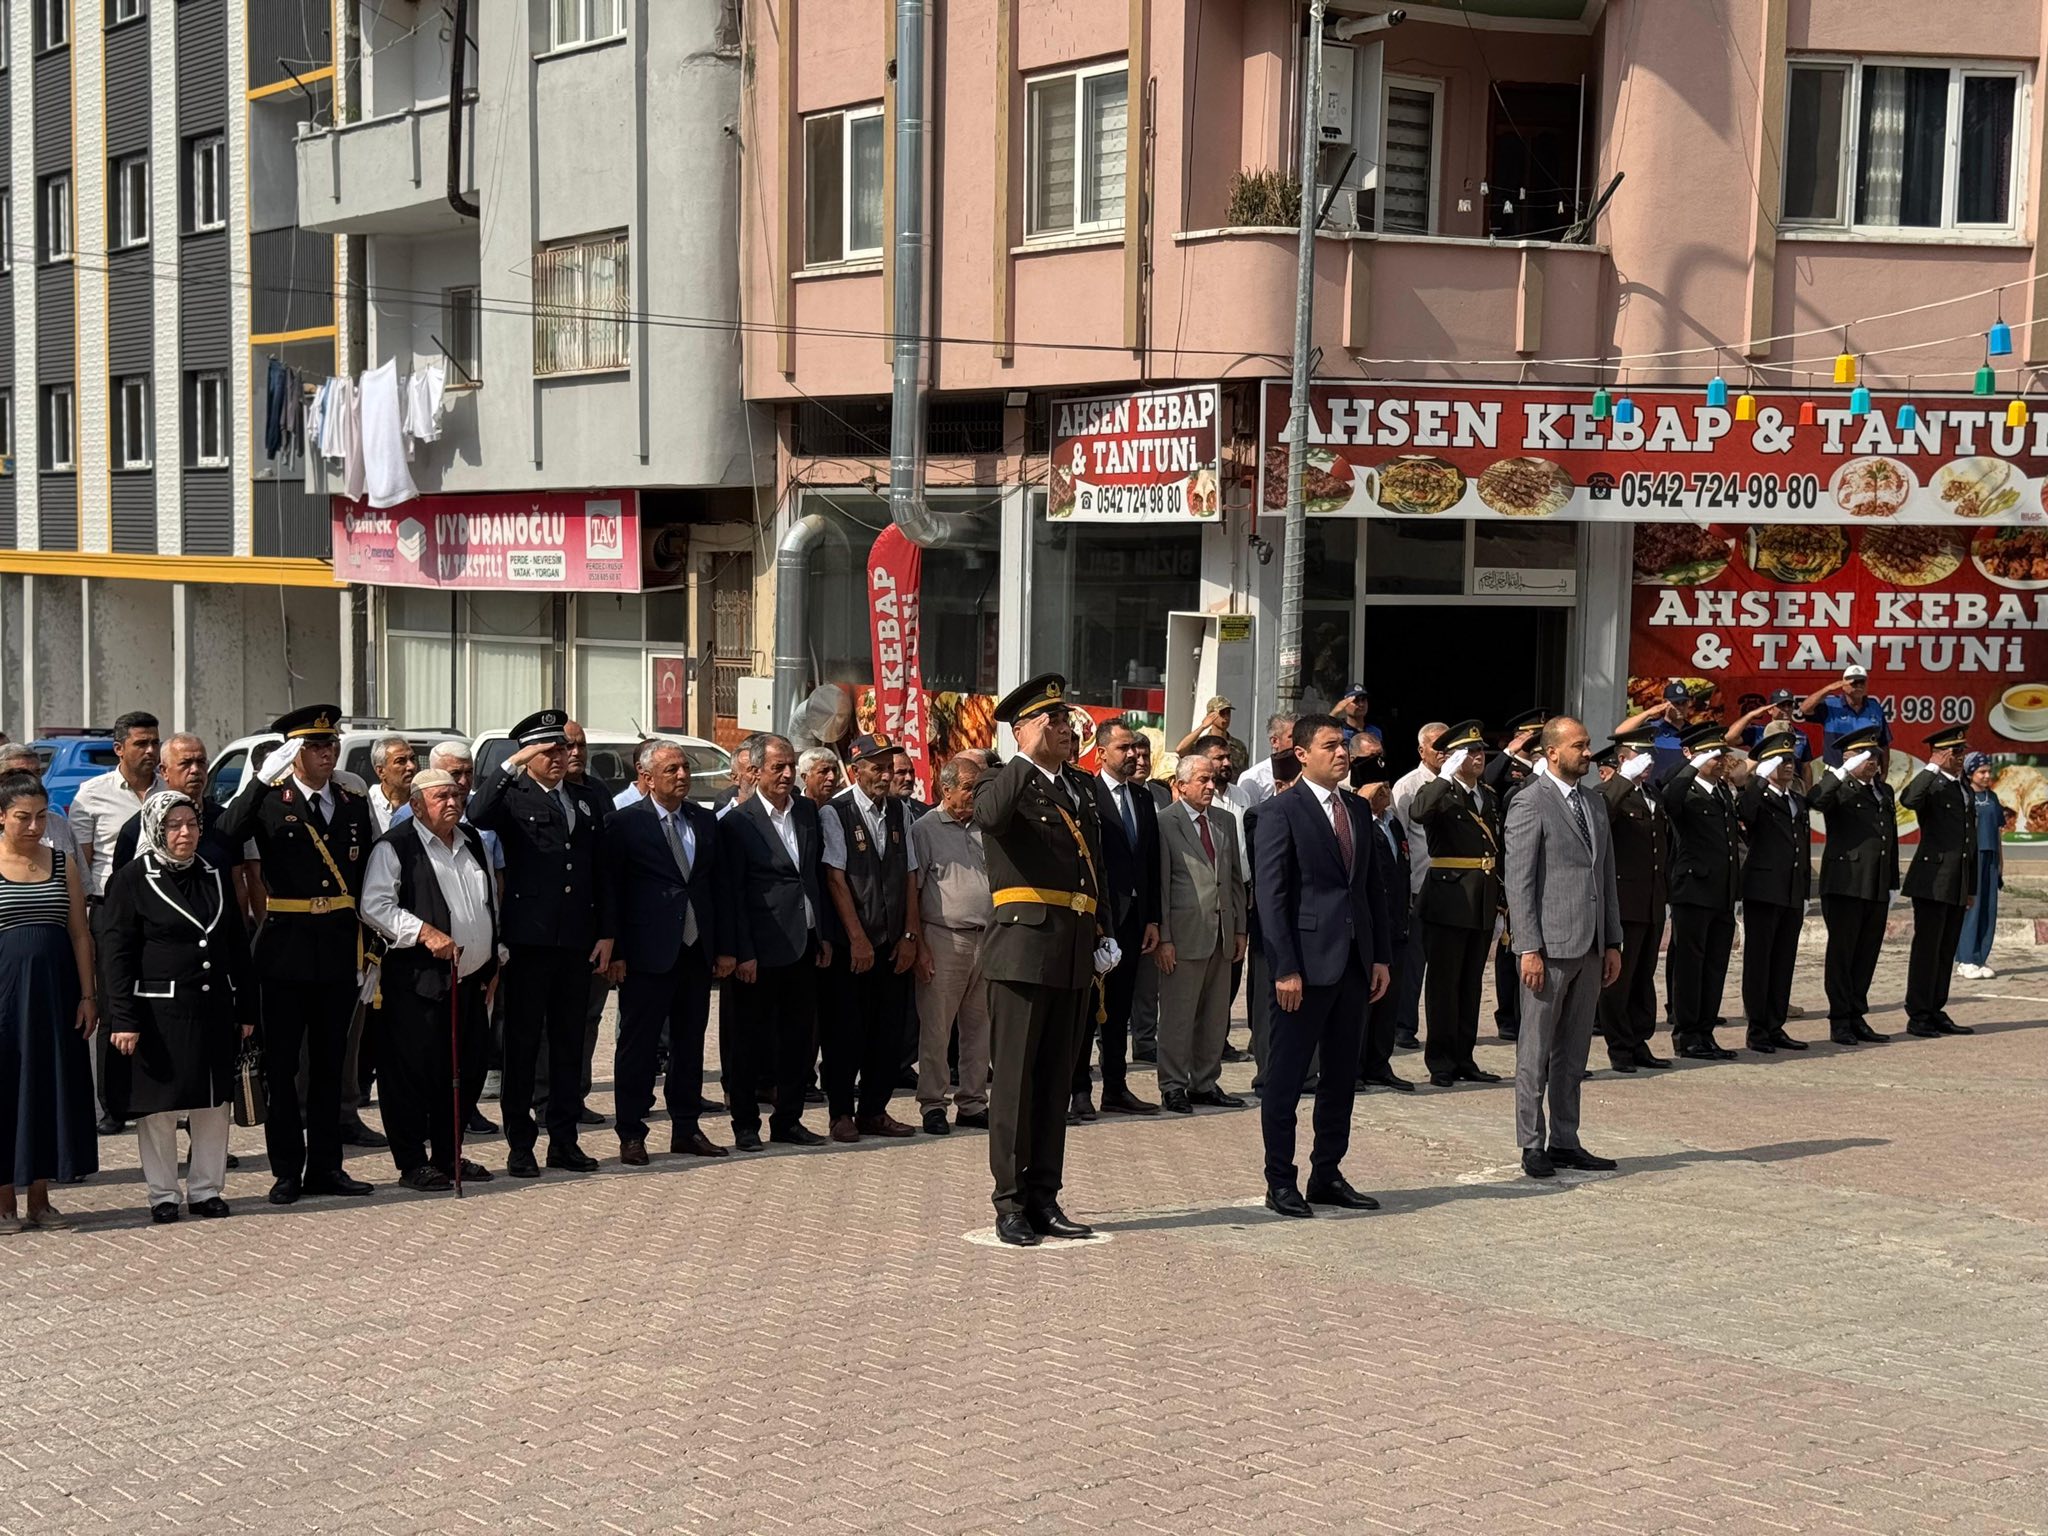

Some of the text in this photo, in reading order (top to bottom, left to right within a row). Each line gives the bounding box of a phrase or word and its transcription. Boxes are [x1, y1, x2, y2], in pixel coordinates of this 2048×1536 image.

[1057, 392, 1214, 437] AHSEN KEBAP
[1278, 397, 1502, 448] AHSEN
[1521, 402, 1732, 453] KEBAP
[1751, 406, 1795, 454] &
[1072, 442, 1086, 476] &
[1097, 485, 1181, 514] 0542 724 98 80
[1621, 473, 1817, 509] 0542 724 98 80
[435, 504, 565, 545] UYDURANOĞLU
[592, 517, 616, 548] TAÇ
[454, 548, 503, 578] TEKSTİLİ
[510, 555, 529, 564] PERDE
[533, 553, 562, 565] NEVRESİM
[513, 568, 530, 577] YATAK
[535, 568, 560, 577] YORGAN
[1648, 589, 1855, 628] AHSEN
[873, 566, 904, 690] KEBAP
[1691, 632, 1733, 670] &
[1901, 696, 1935, 723] 98
[1940, 697, 1975, 723] 80
